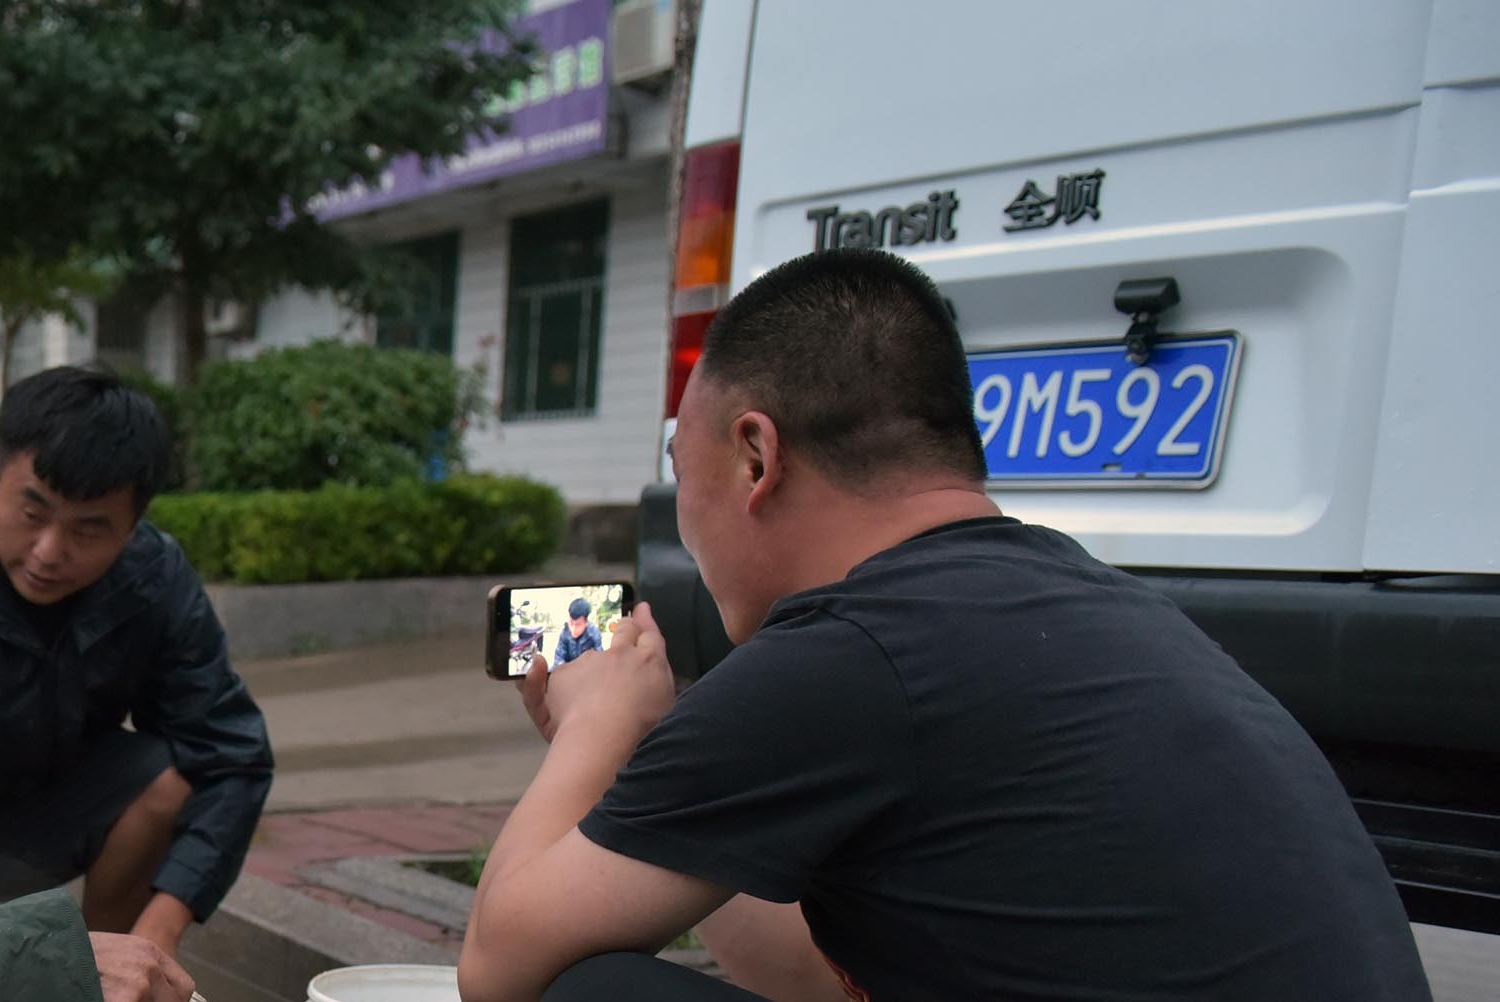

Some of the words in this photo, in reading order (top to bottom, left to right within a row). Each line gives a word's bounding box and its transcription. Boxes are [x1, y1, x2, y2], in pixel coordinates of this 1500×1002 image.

[806, 188, 960, 249] Transit
[1002, 168, 1106, 233] 全顺
[975, 362, 1215, 459] 9M592
